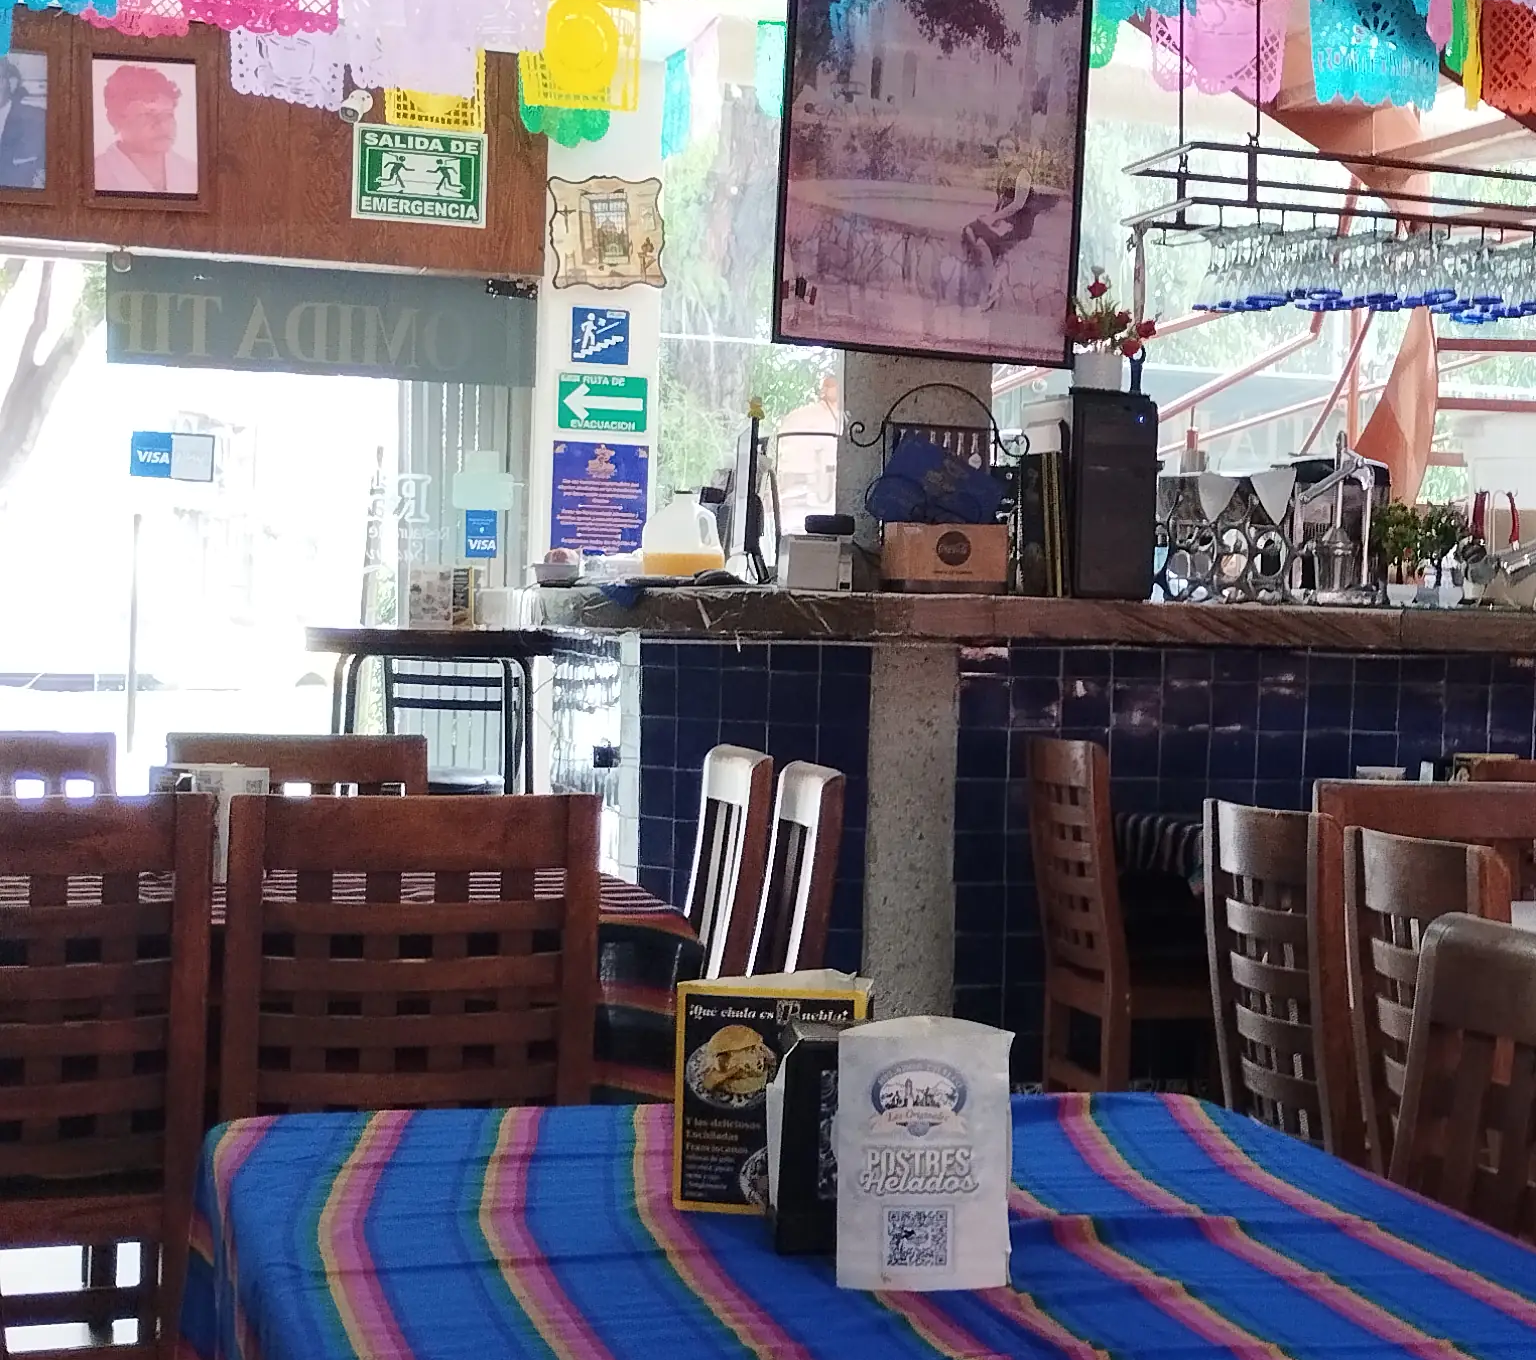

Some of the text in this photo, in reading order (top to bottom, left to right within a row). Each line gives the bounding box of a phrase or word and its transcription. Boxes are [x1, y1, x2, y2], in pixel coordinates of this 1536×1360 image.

[363, 132, 479, 155] SALIDA DE
[361, 196, 479, 220] EMERGENCIA
[582, 375, 610, 386] RUTA
[611, 376, 626, 387] DE
[136, 449, 170, 464] VISA
[467, 538, 497, 551] VISA
[721, 1006, 757, 1020] chula
[759, 1010, 775, 1020] es
[866, 1146, 972, 1177] POSTRES
[860, 1169, 980, 1197] Helados
